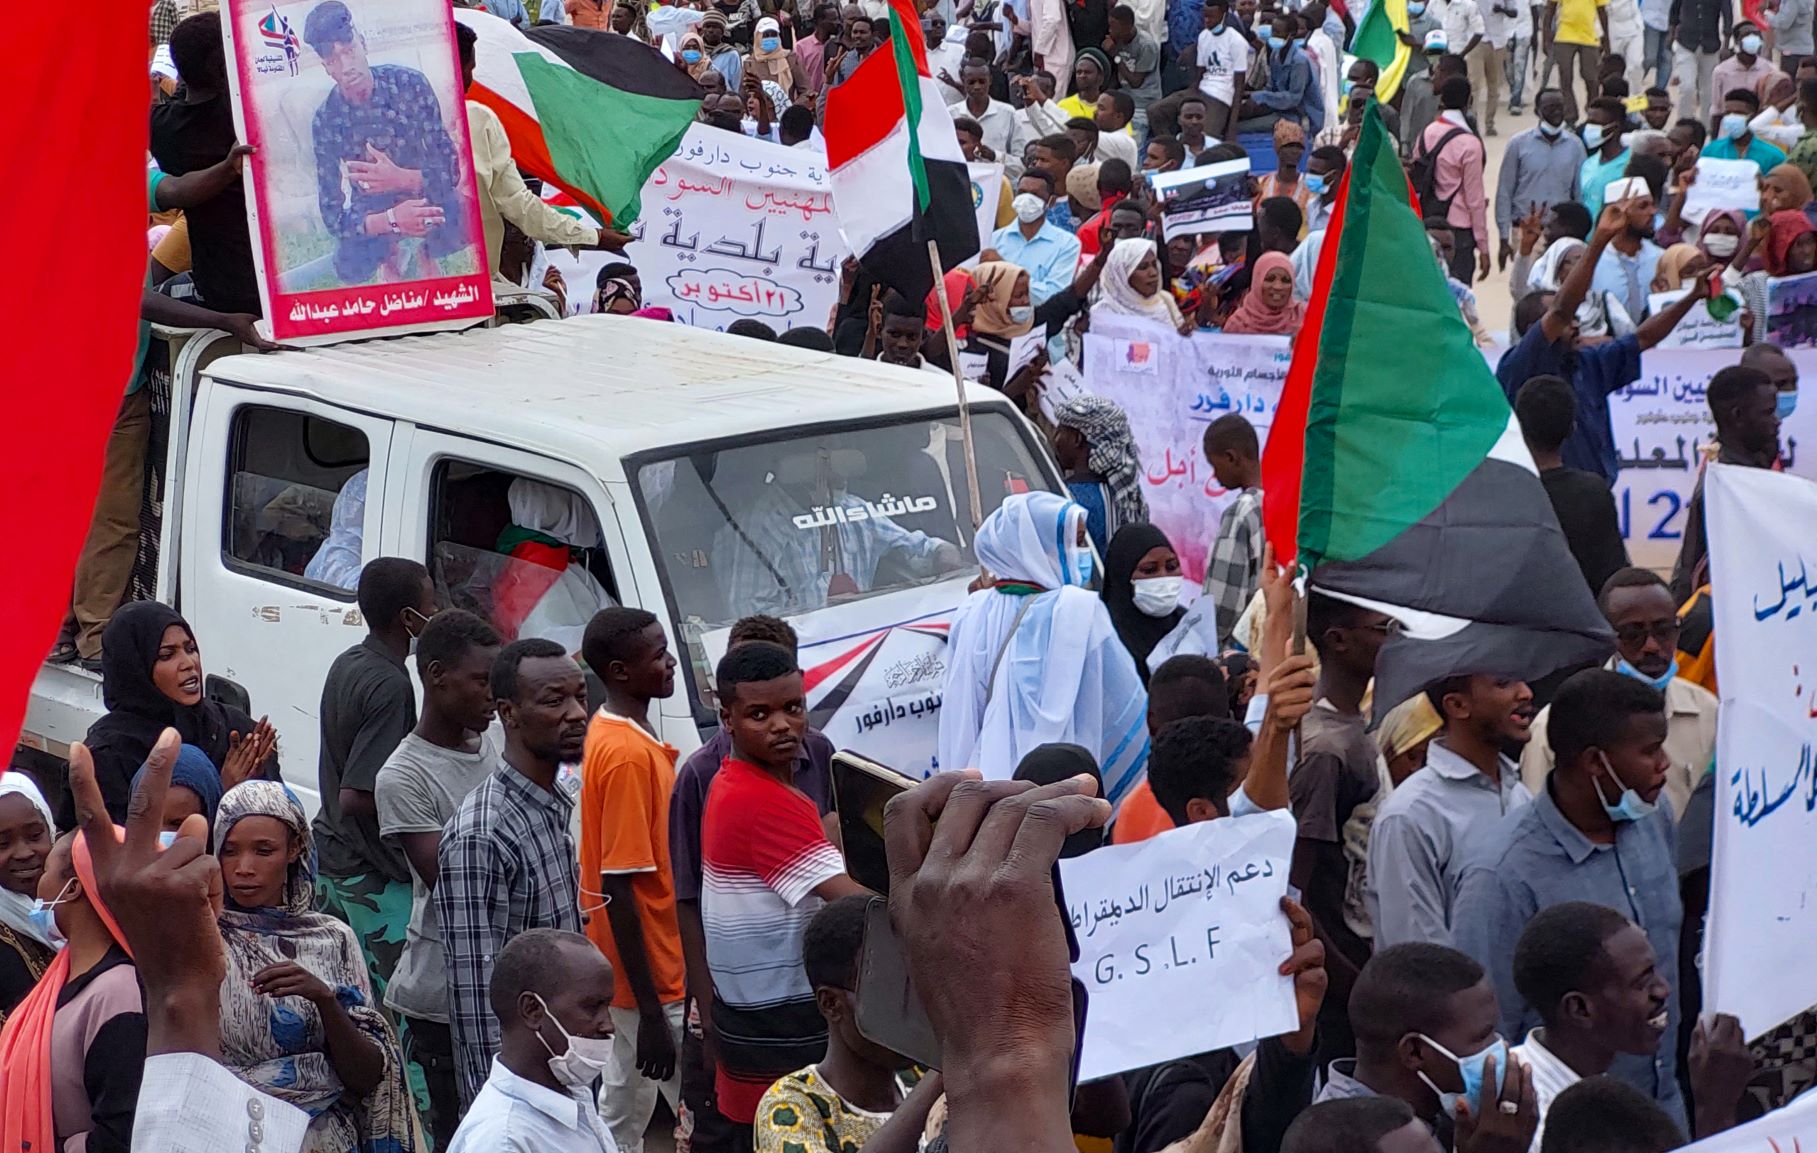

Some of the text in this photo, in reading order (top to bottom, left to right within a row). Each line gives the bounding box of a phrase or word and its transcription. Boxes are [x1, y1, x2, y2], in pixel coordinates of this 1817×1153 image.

[674, 139, 730, 166] دارفور
[740, 158, 798, 178] جنوب
[744, 185, 834, 221] لمهنيين
[660, 206, 784, 277] بلدية
[342, 296, 376, 317] حامد
[432, 282, 480, 311] الشهيد
[681, 281, 761, 305] أكتوبر
[1147, 445, 1197, 489] أجل
[1615, 433, 1700, 472] المعل
[855, 689, 943, 734] نوب دارفور
[1070, 858, 1274, 938] دعم الإنتقال الديمقراط
